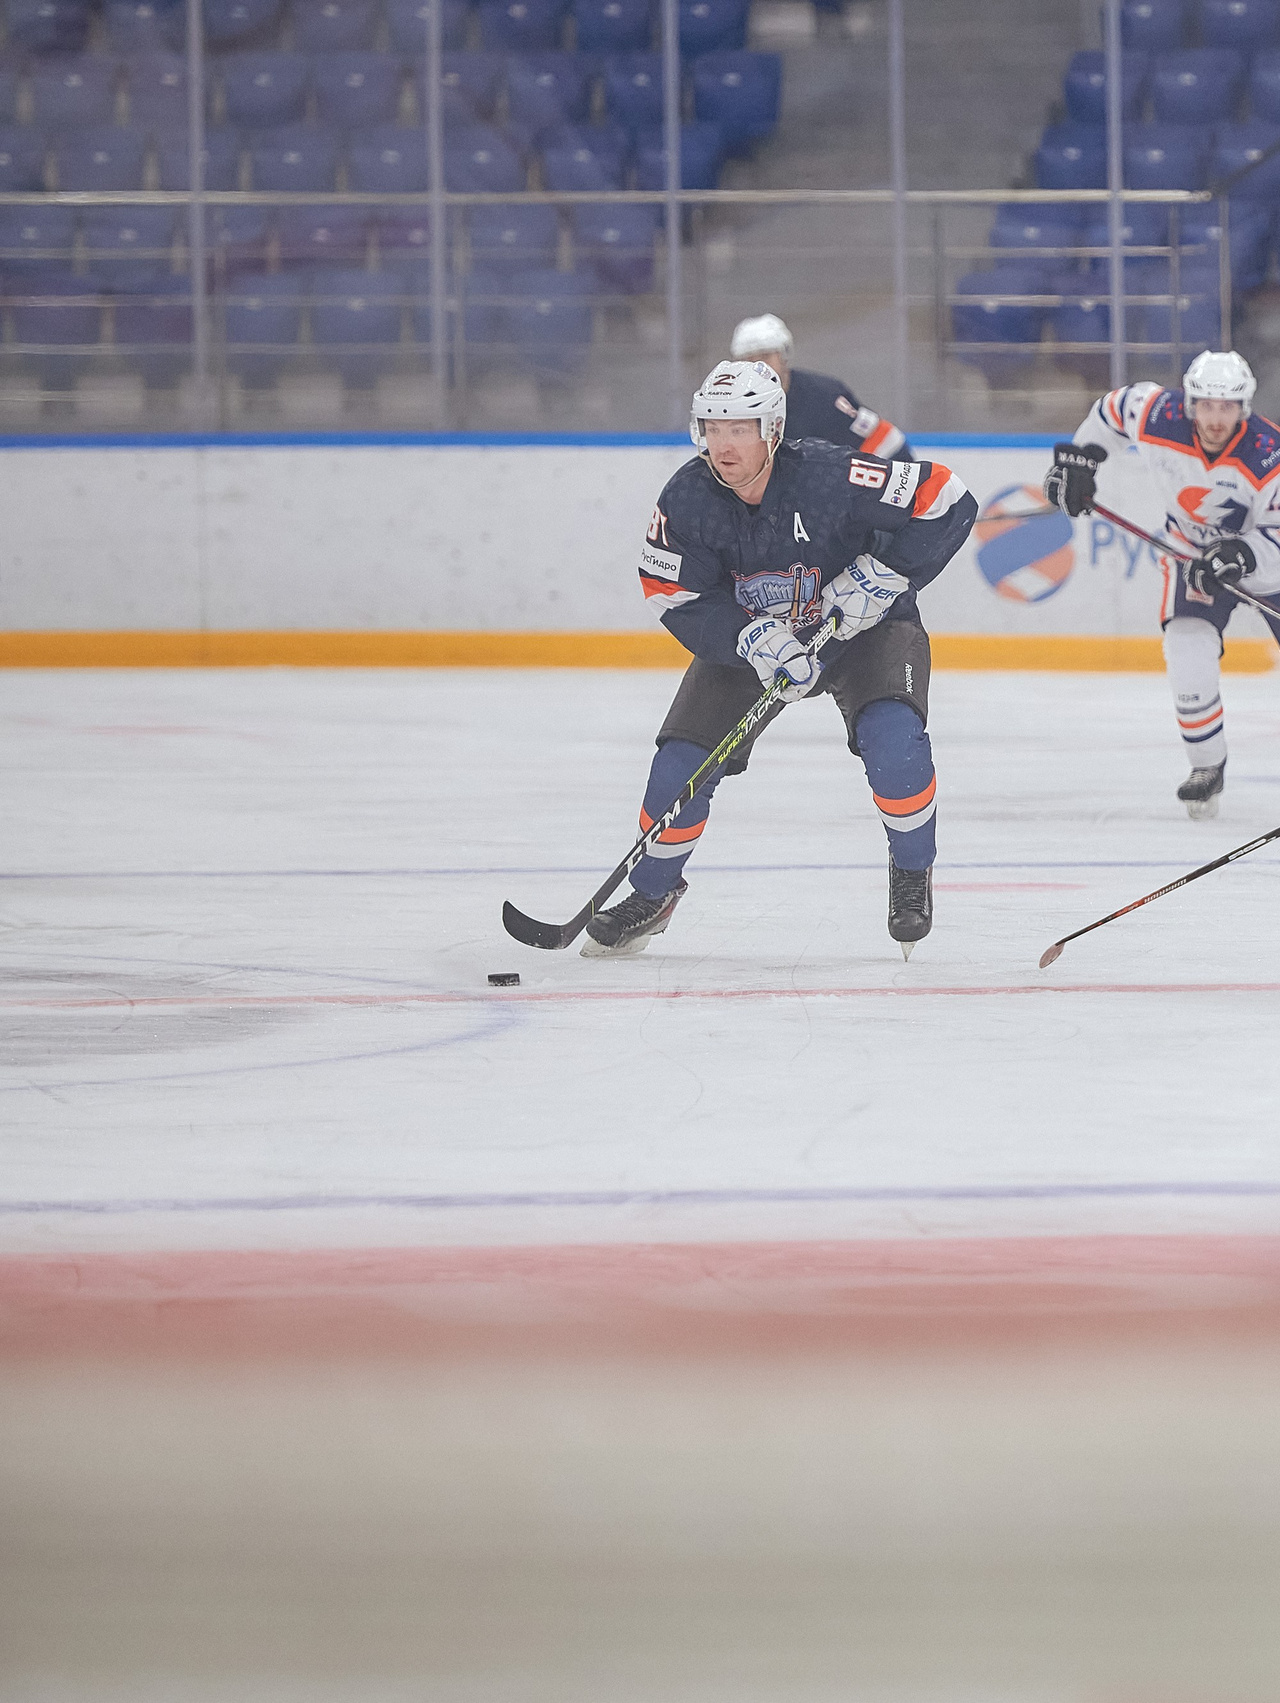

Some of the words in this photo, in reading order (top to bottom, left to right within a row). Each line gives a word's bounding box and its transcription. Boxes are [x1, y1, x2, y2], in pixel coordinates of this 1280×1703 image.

[848, 457, 889, 490] 81
[893, 460, 913, 497] РусГидр
[793, 511, 811, 544] A
[904, 662, 914, 695] Reebok
[626, 798, 682, 874] CCM
